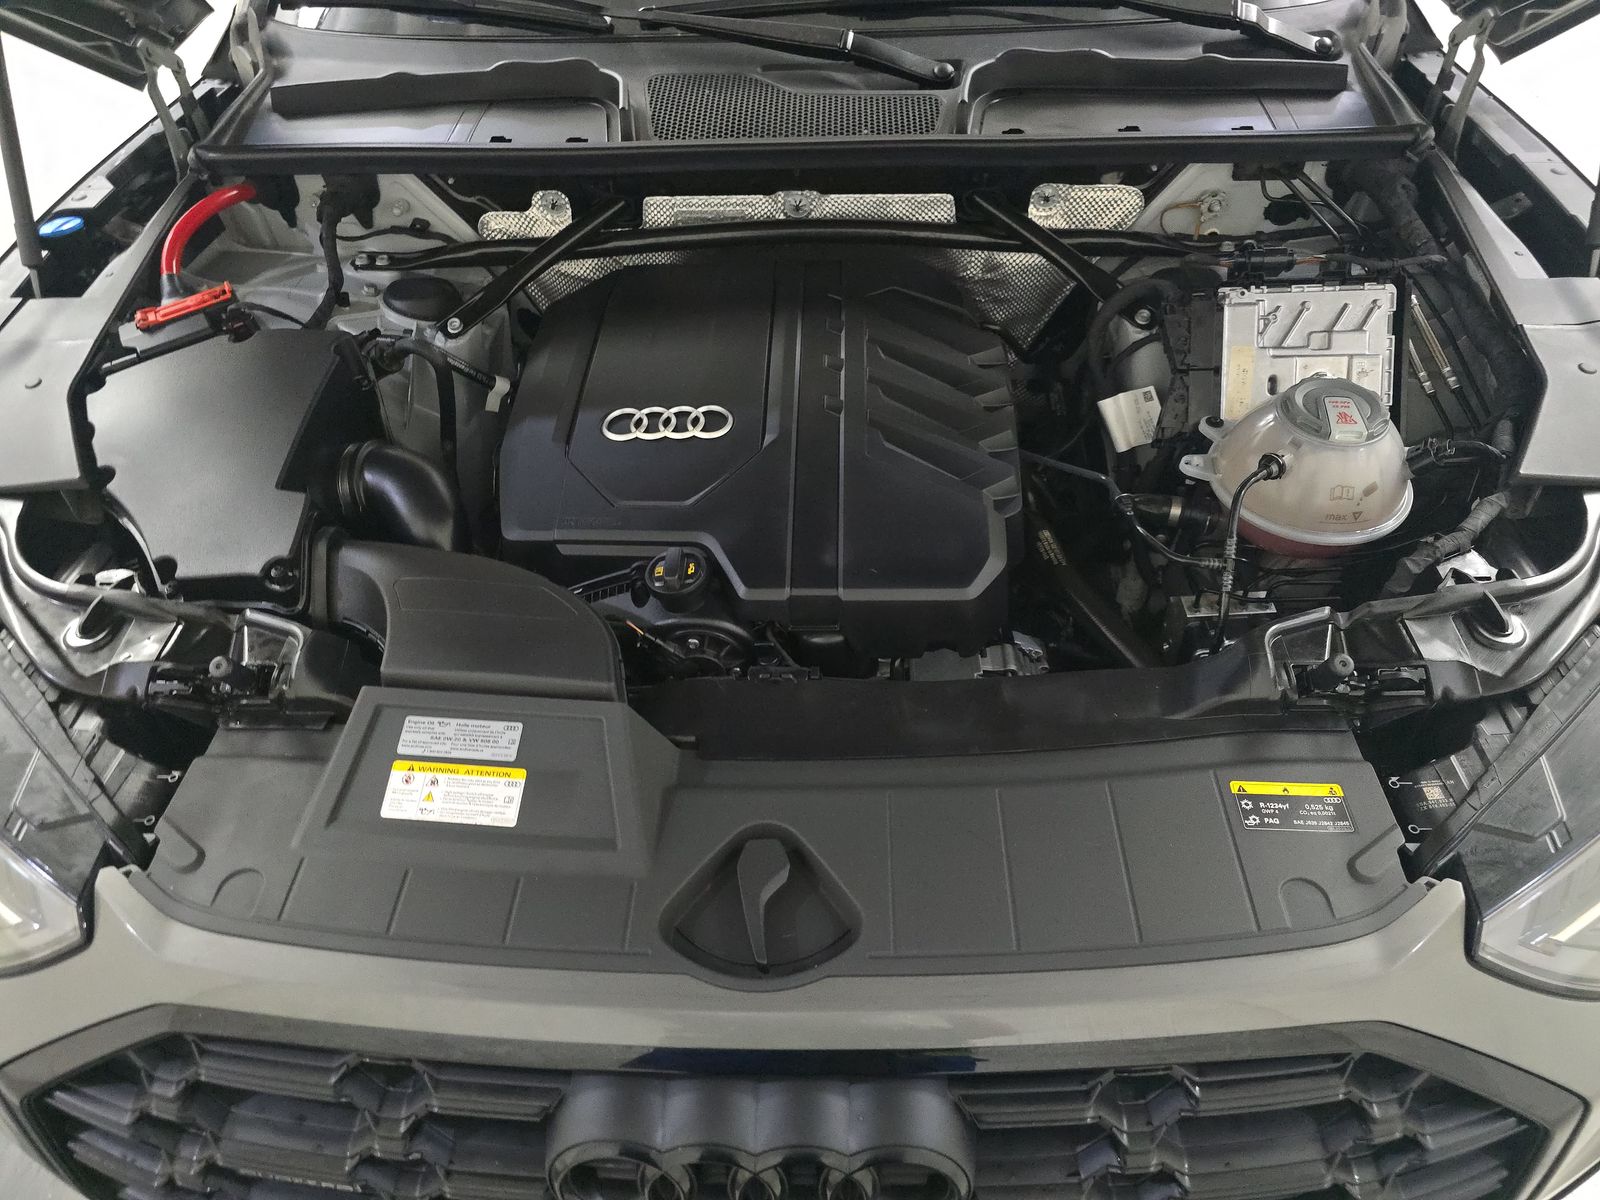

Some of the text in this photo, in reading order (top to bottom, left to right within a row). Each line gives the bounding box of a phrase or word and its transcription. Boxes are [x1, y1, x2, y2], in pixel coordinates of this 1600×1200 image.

[1325, 512, 1347, 521] max
[418, 765, 512, 778] WARNING ATTENTION
[1259, 802, 1290, 810] R-1234yf
